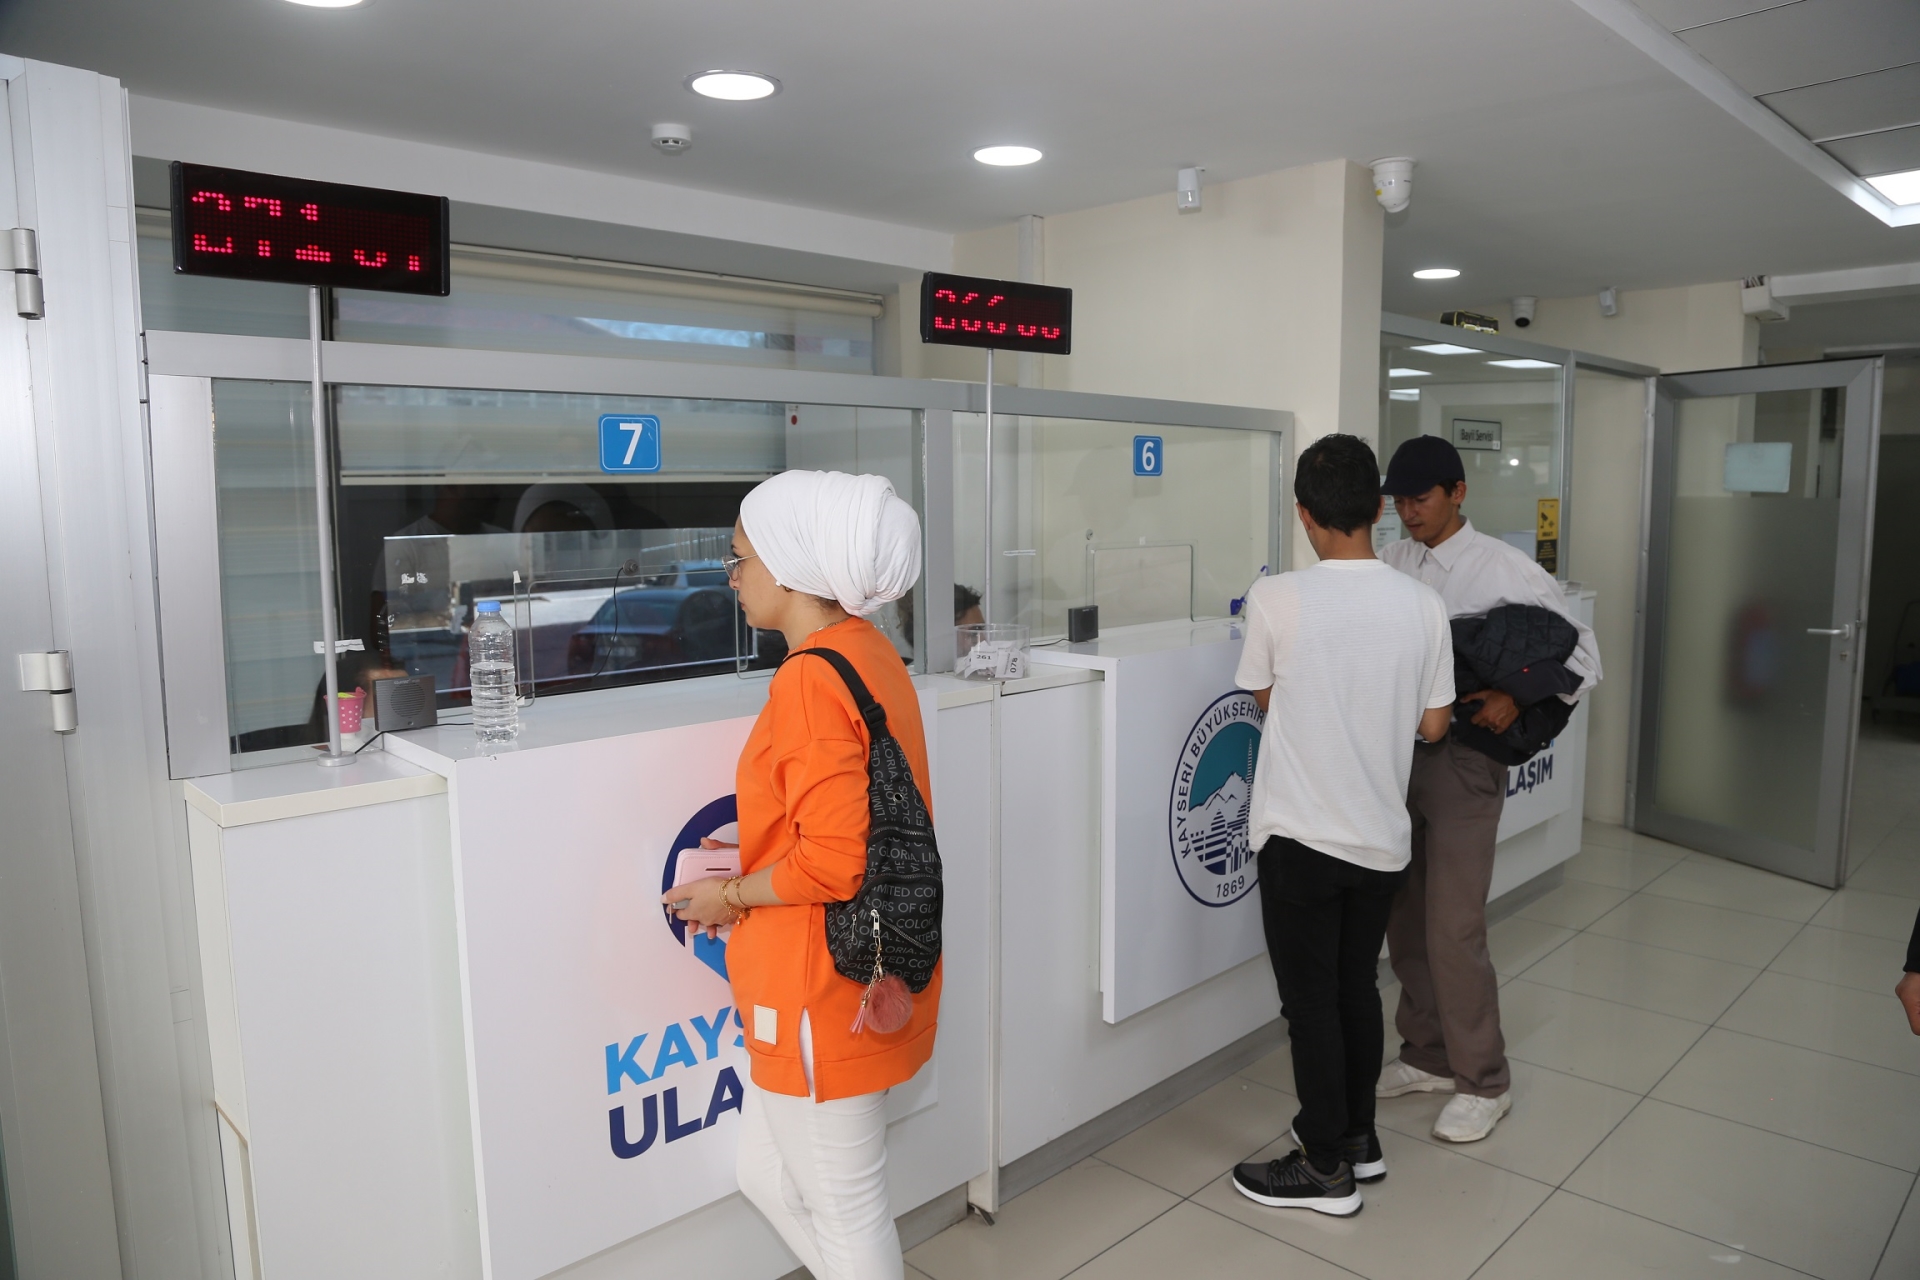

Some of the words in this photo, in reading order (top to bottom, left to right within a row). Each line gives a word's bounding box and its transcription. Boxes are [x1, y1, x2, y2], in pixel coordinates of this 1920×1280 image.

[619, 422, 643, 465] 7
[1142, 441, 1156, 472] 6
[1175, 760, 1195, 860] KAYSERİ
[1215, 875, 1246, 899] 1869
[898, 902, 917, 914] OF
